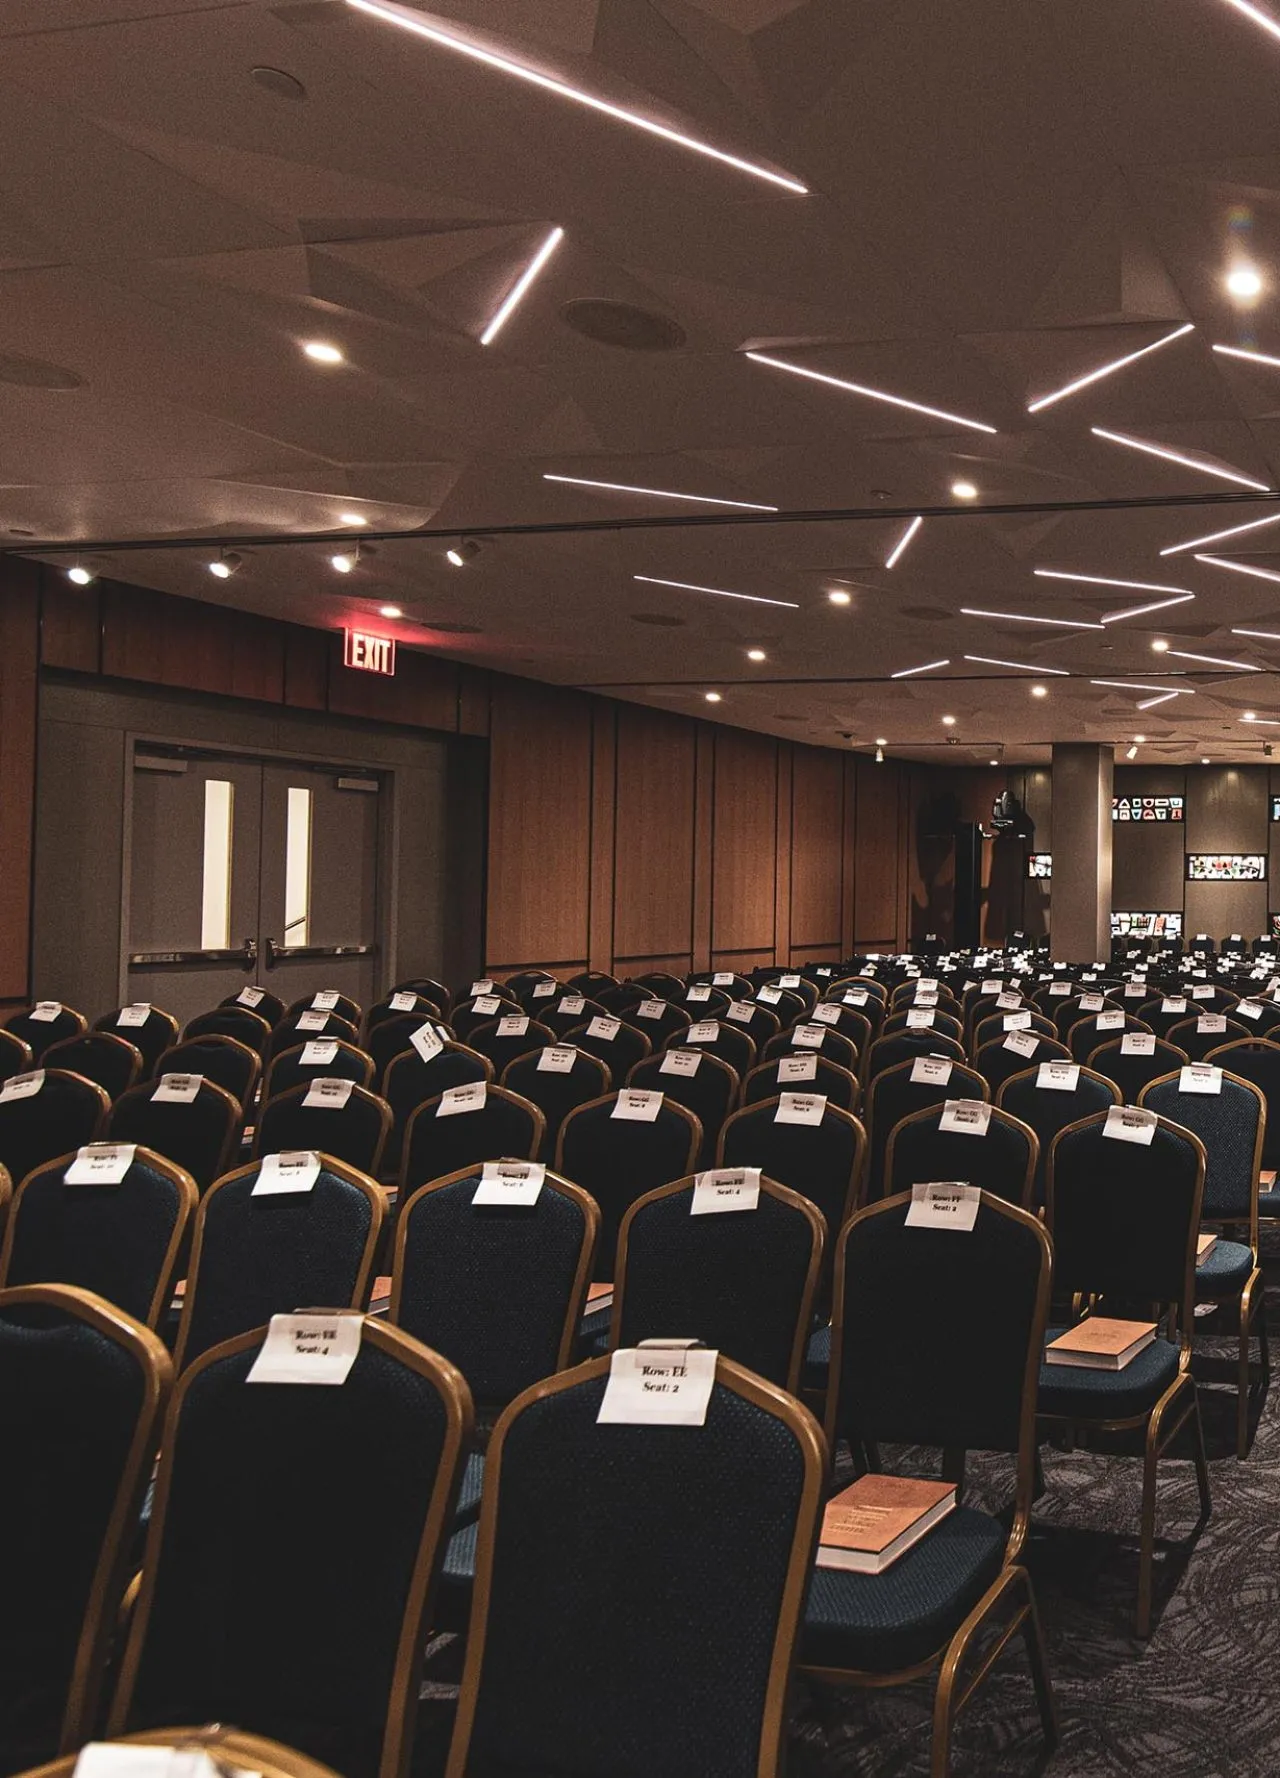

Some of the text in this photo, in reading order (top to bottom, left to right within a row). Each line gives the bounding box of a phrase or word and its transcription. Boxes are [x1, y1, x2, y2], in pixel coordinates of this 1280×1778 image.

[352, 632, 391, 673] EXIT
[932, 1203, 951, 1211] Seat:
[295, 1329, 321, 1341] Row:
[295, 1344, 330, 1356] Seat: 4
[641, 1365, 688, 1378] Row: EE
[641, 1381, 680, 1394] Seat: 2
